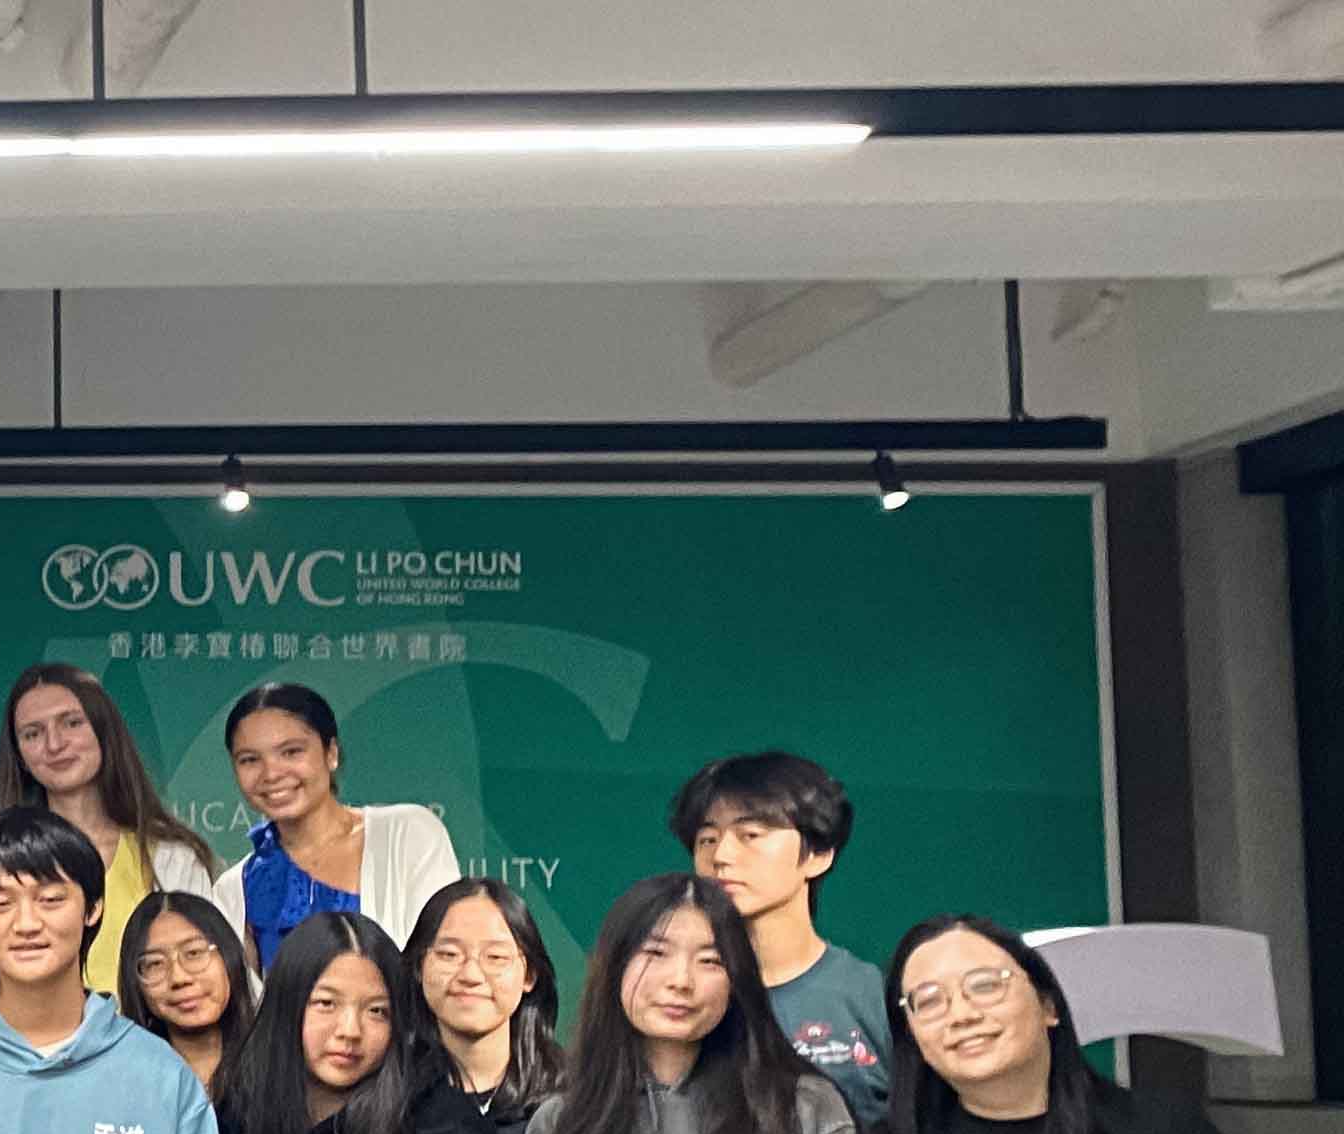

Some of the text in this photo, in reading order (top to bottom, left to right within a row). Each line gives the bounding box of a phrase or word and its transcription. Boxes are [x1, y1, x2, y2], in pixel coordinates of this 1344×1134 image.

[356, 551, 521, 575] LI PO CHUN
[170, 550, 344, 607] UWC
[356, 577, 521, 592] UNITED WORLD COLLEGE
[356, 593, 465, 606] OF HONG KONG
[108, 632, 467, 659] 香港李寶椿聯合世界書院
